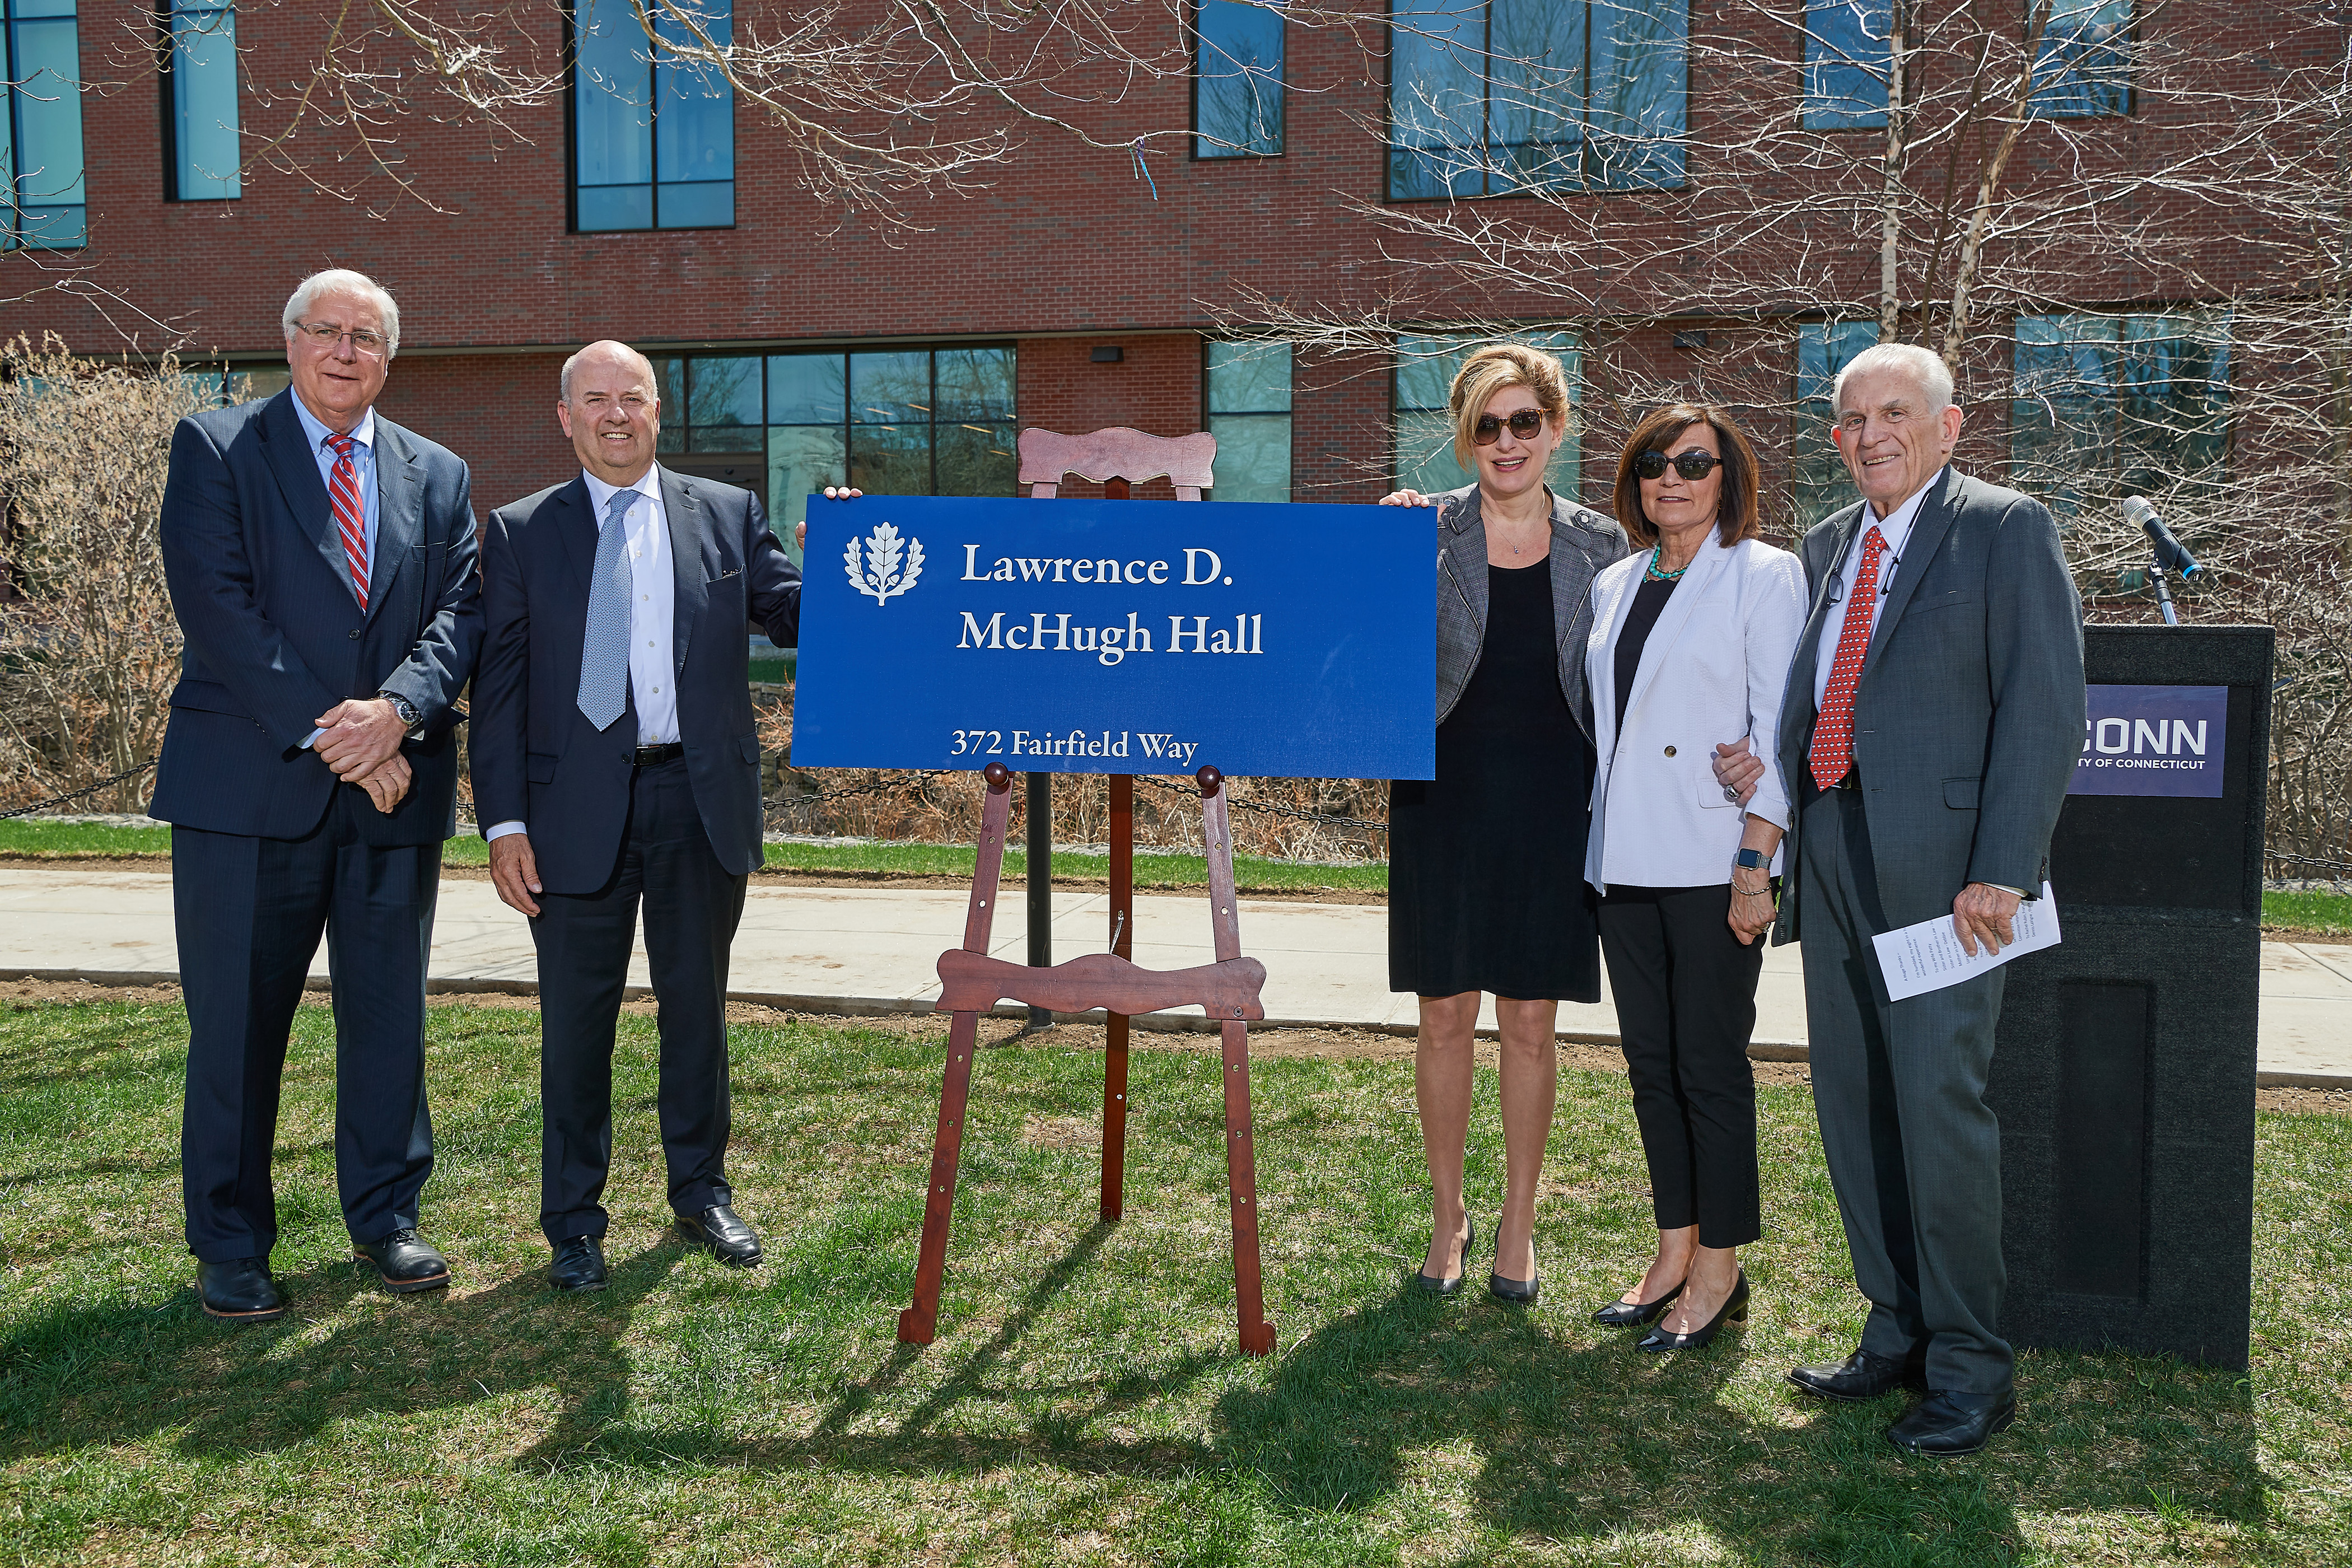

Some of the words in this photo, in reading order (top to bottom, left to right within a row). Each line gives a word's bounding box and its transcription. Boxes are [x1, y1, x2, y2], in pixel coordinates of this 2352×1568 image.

[960, 545, 1168, 584] Lawrence
[1181, 549, 1232, 585] D.
[956, 612, 1154, 665] McHugh
[1166, 614, 1263, 654] Hall
[951, 730, 1002, 754] 372
[1011, 730, 1129, 757] Fairfield
[1137, 734, 1198, 767] Way
[2096, 759, 2112, 767] OF
[2116, 759, 2205, 769] CONNECTICUT
[1918, 958, 1926, 977] wonderful
